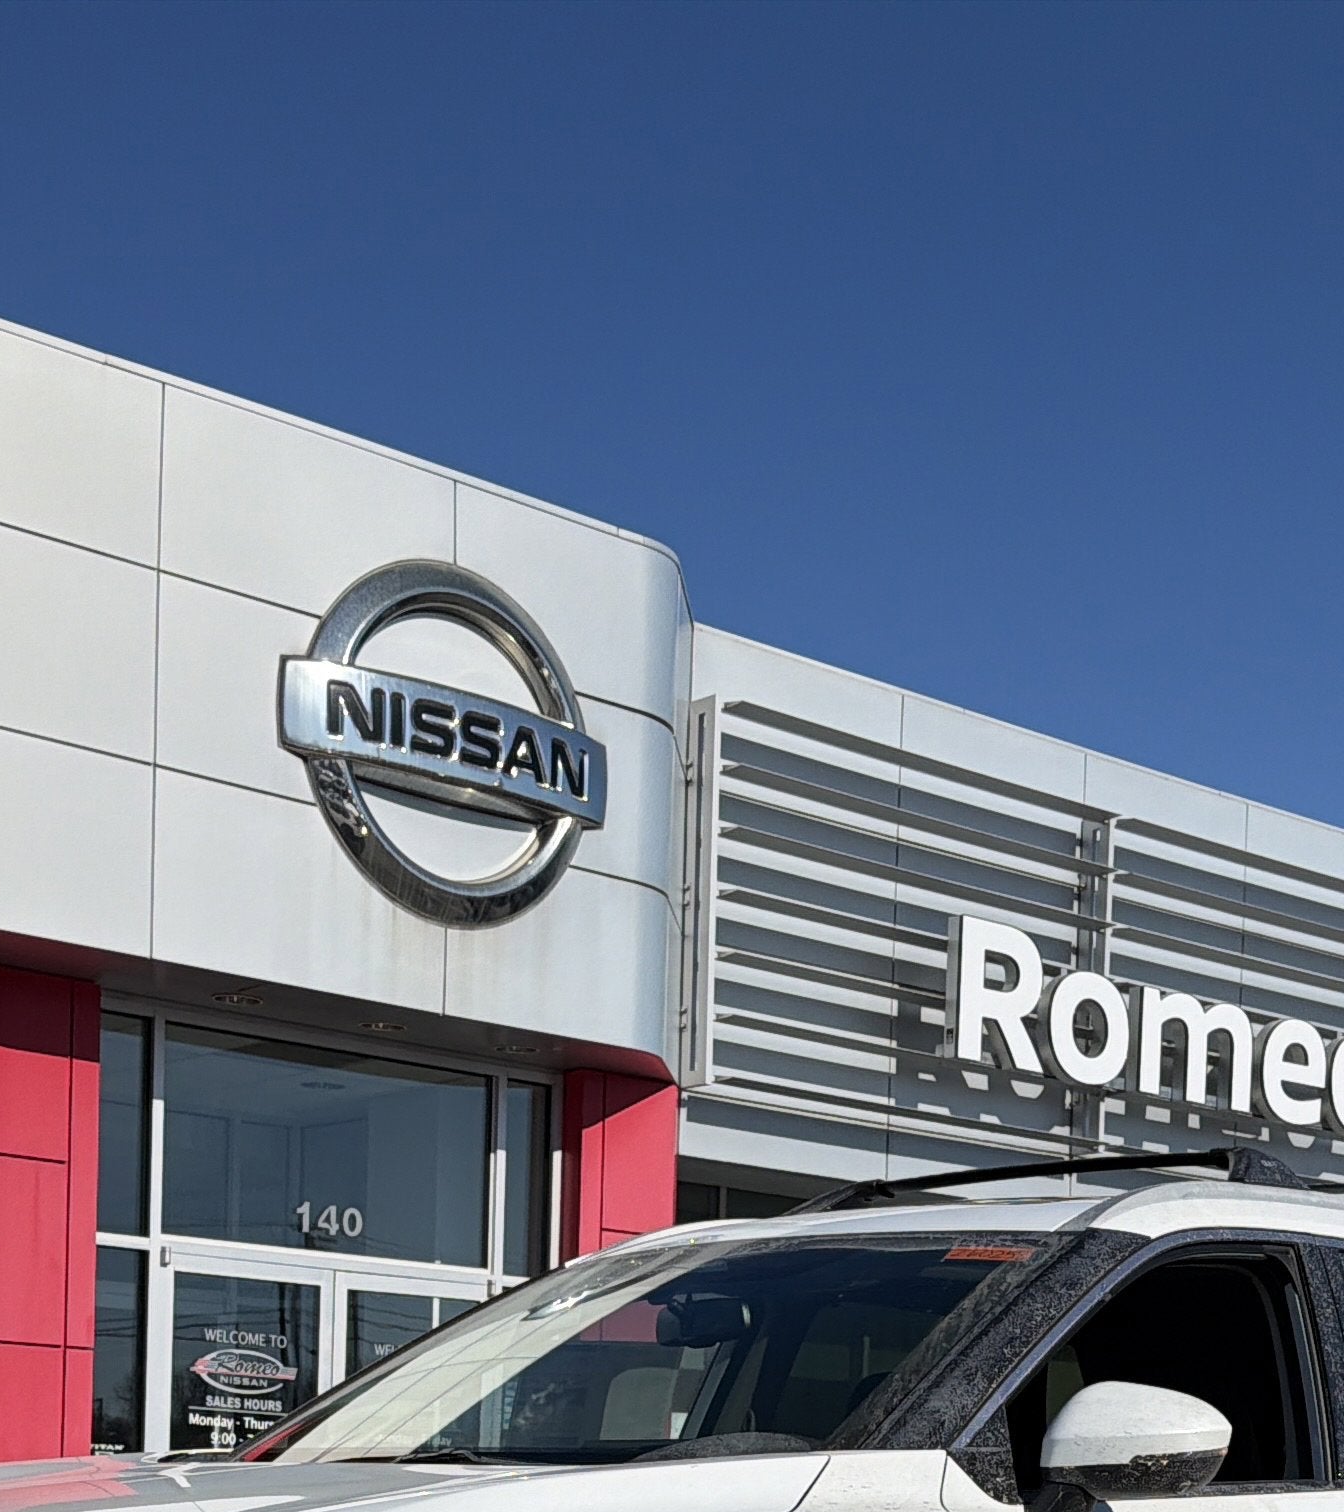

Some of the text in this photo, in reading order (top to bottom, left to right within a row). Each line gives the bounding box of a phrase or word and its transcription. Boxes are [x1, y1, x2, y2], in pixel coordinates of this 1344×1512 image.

[326, 678, 588, 803] NISSAN
[296, 1200, 363, 1238] 140
[204, 1328, 288, 1349] WELCOME TO
[215, 1351, 281, 1377] Romeo
[219, 1375, 269, 1388] NISSAN
[205, 1394, 283, 1411] SALES HOURS
[188, 1413, 234, 1430] Monday
[210, 1432, 237, 1445] 9:00
